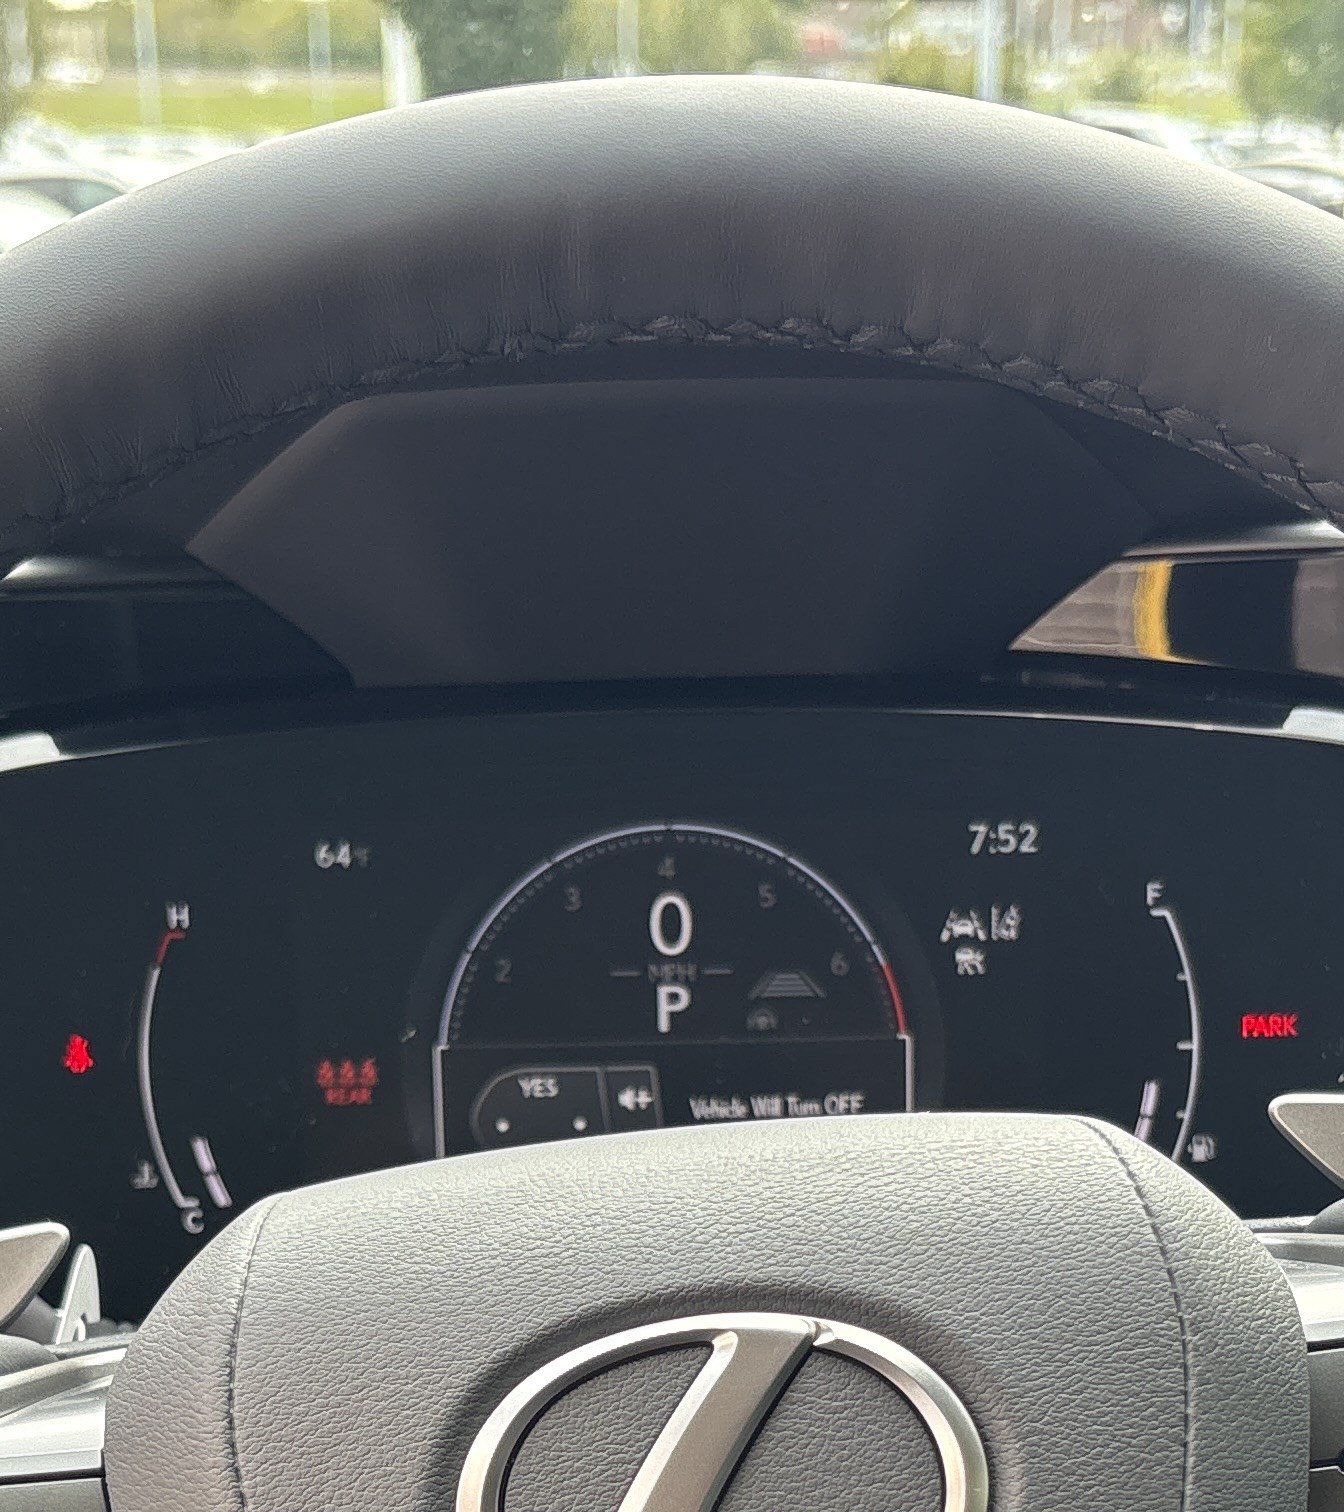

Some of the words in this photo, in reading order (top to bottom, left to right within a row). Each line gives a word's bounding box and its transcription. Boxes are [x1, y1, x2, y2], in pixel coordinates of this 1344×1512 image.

[968, 823, 1040, 855] 7:52
[658, 856, 677, 879] 4
[563, 886, 583, 912] 3
[758, 882, 777, 909] 5
[1146, 881, 1165, 905] F
[166, 902, 190, 929] H
[830, 951, 850, 977] 6
[657, 985, 692, 1033] P
[1241, 1014, 1298, 1038] PARK
[517, 1077, 559, 1099] YES
[689, 1094, 750, 1121] Vehicle
[750, 1094, 785, 1118] Will
[786, 1092, 823, 1116] Turn
[824, 1091, 865, 1115] OFF
[181, 1207, 205, 1234] C
